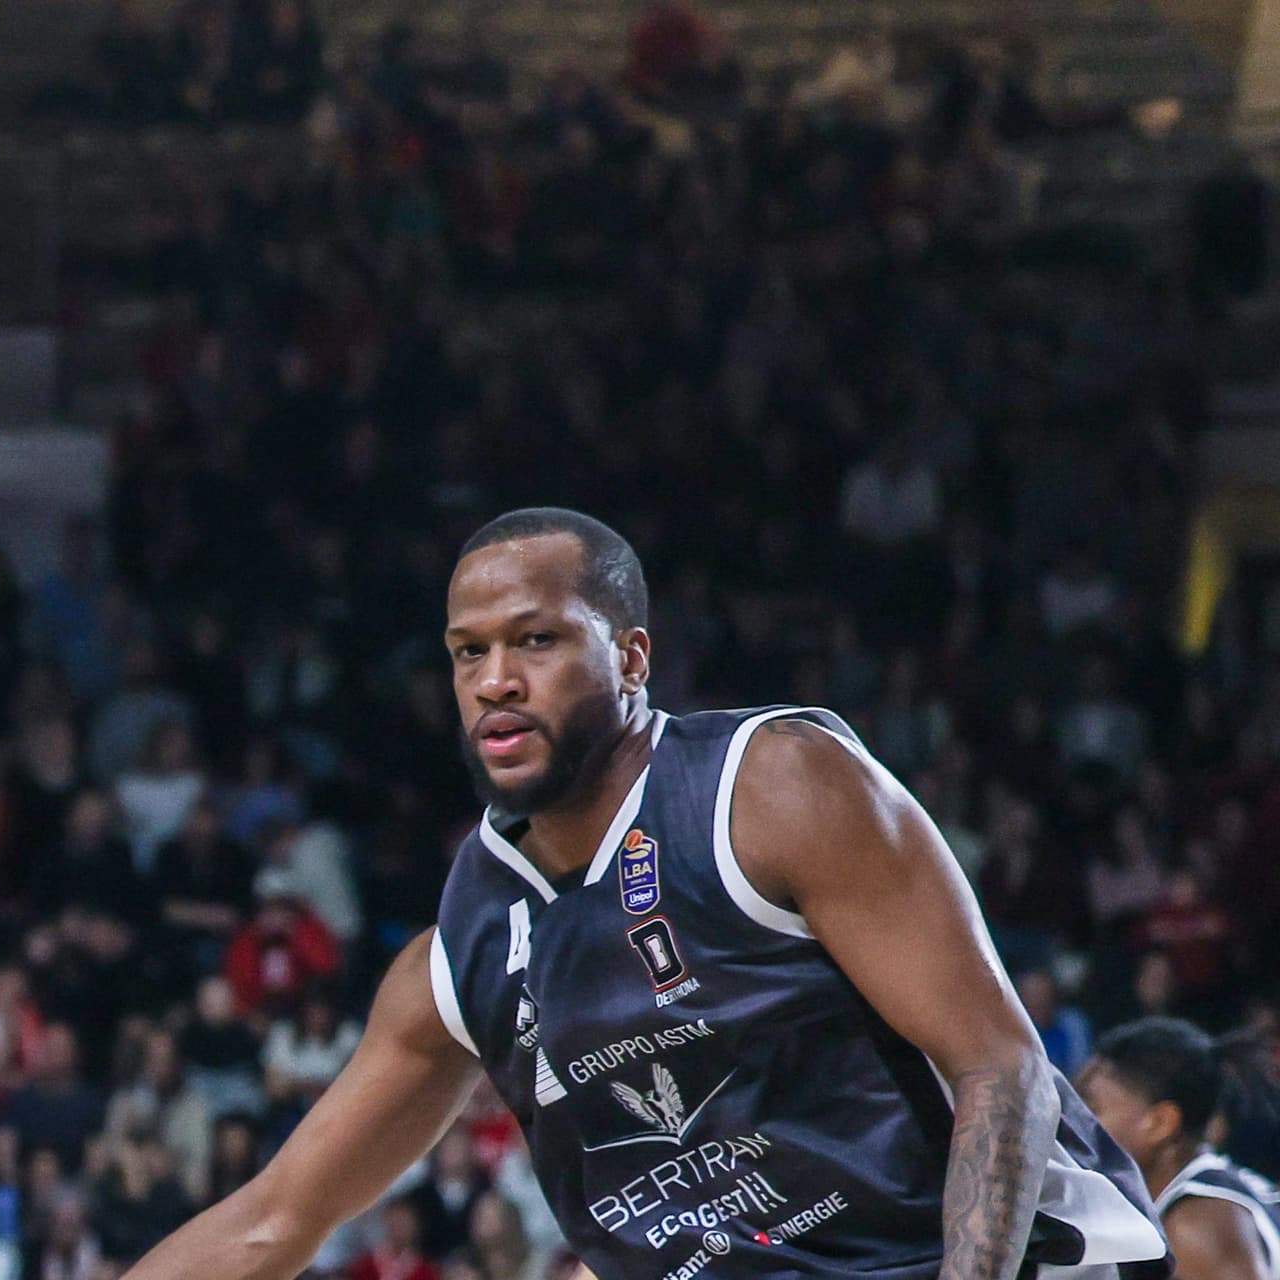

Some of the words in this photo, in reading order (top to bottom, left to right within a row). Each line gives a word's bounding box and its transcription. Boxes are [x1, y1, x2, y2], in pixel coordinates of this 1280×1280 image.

[624, 861, 653, 880] LBA
[655, 977, 701, 1008] DERTHONA
[519, 1022, 540, 1048] err
[568, 1035, 655, 1084] GRUPPO
[653, 1018, 715, 1049] ASTM
[767, 1191, 848, 1245] SYNERGIE
